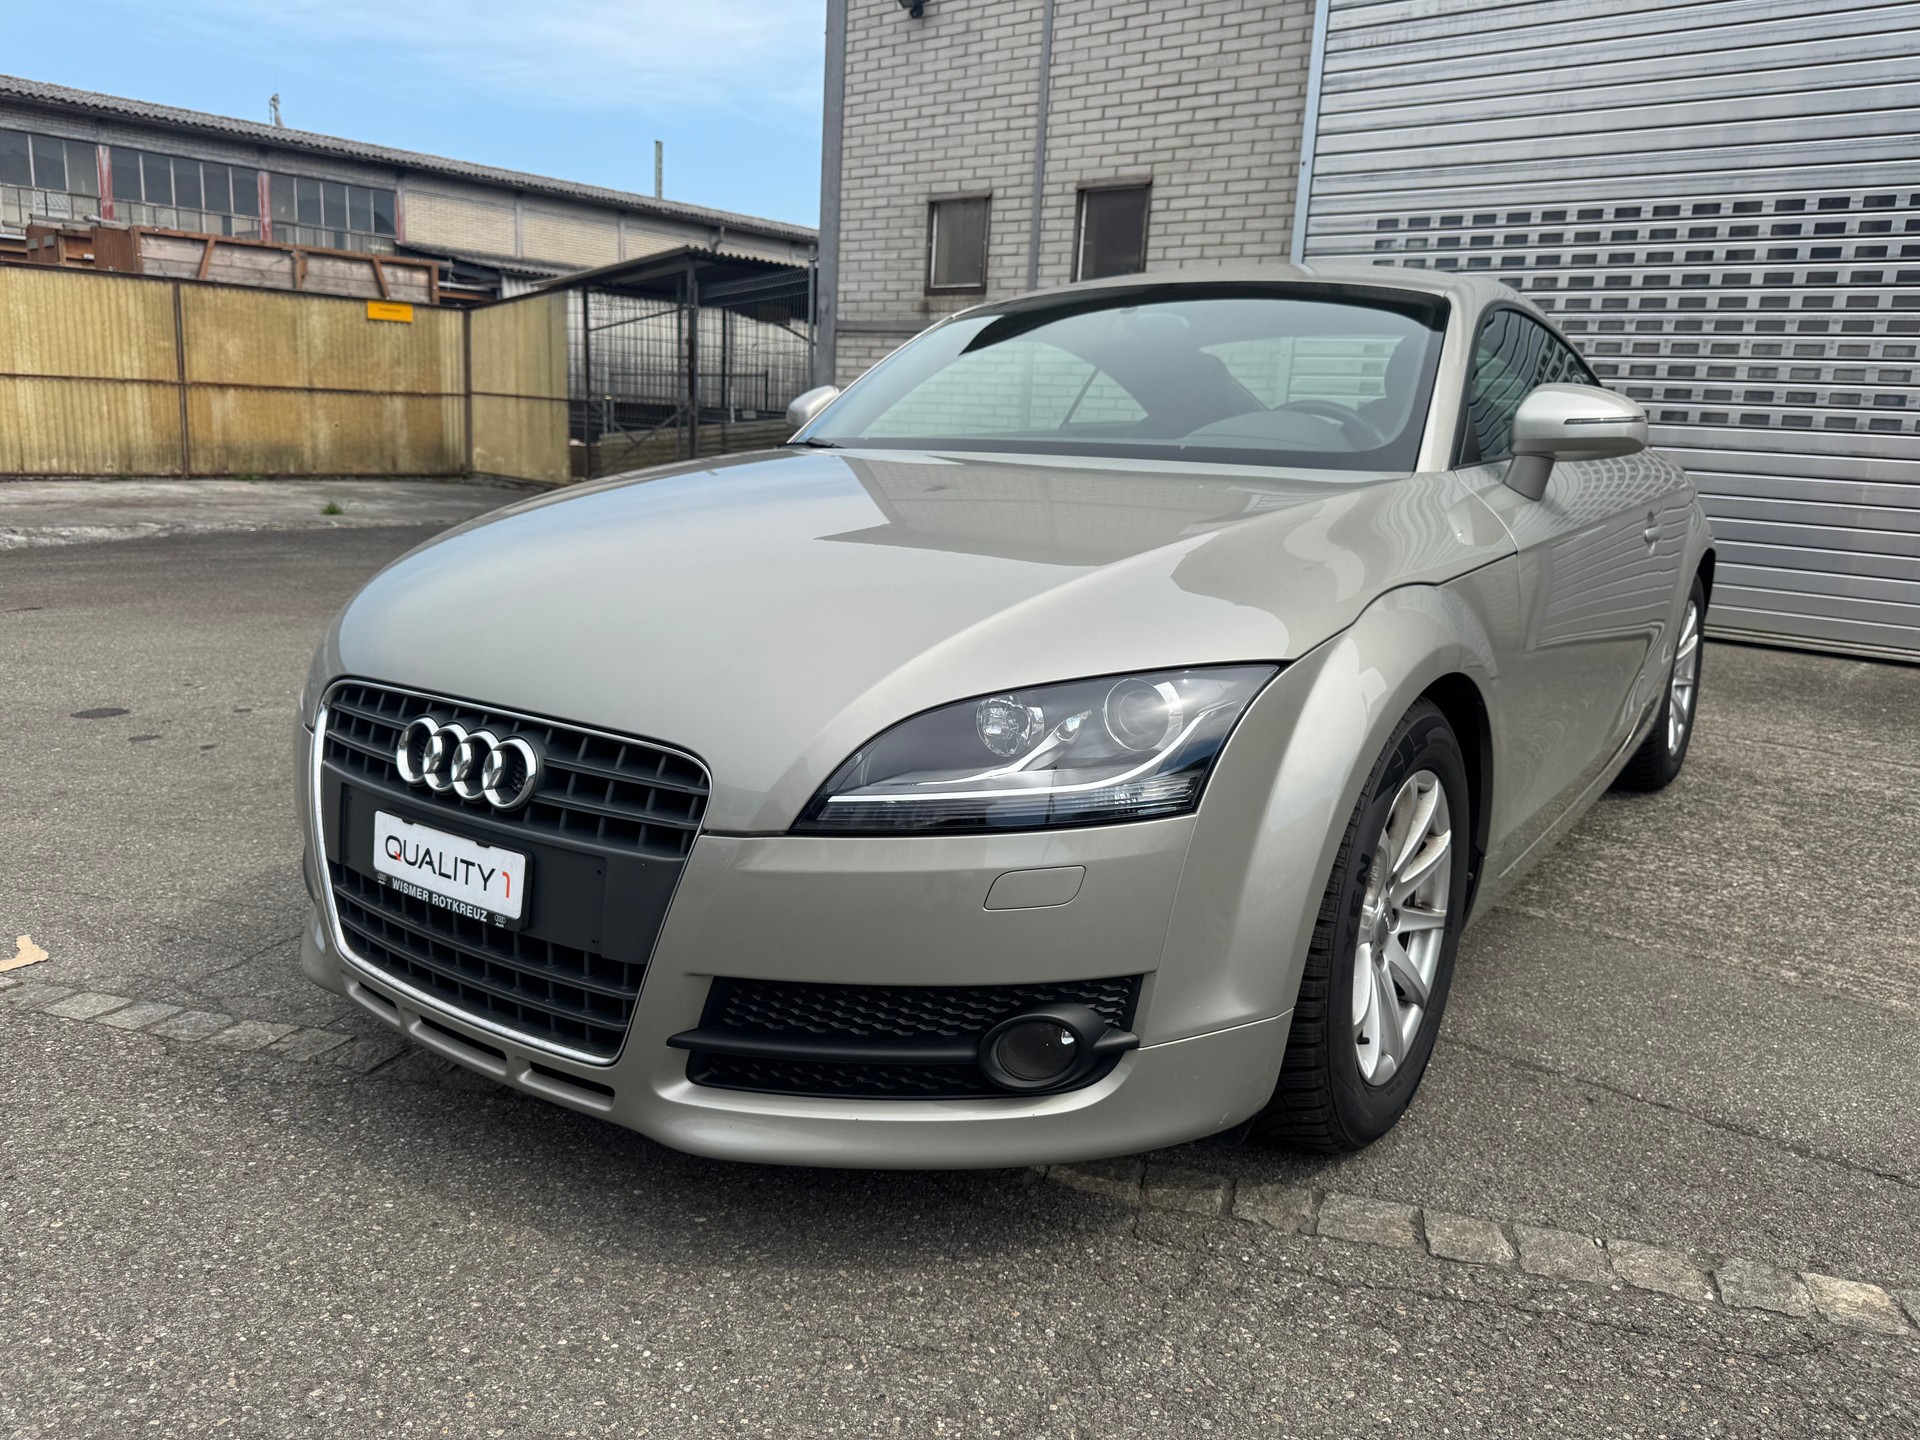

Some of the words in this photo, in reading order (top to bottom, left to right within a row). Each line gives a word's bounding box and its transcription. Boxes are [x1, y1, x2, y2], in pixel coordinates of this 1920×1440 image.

[386, 835, 496, 891] QUALITY
[503, 871, 511, 898] 1
[392, 879, 429, 902] WISMER
[433, 893, 488, 922] ROTKREUZ
